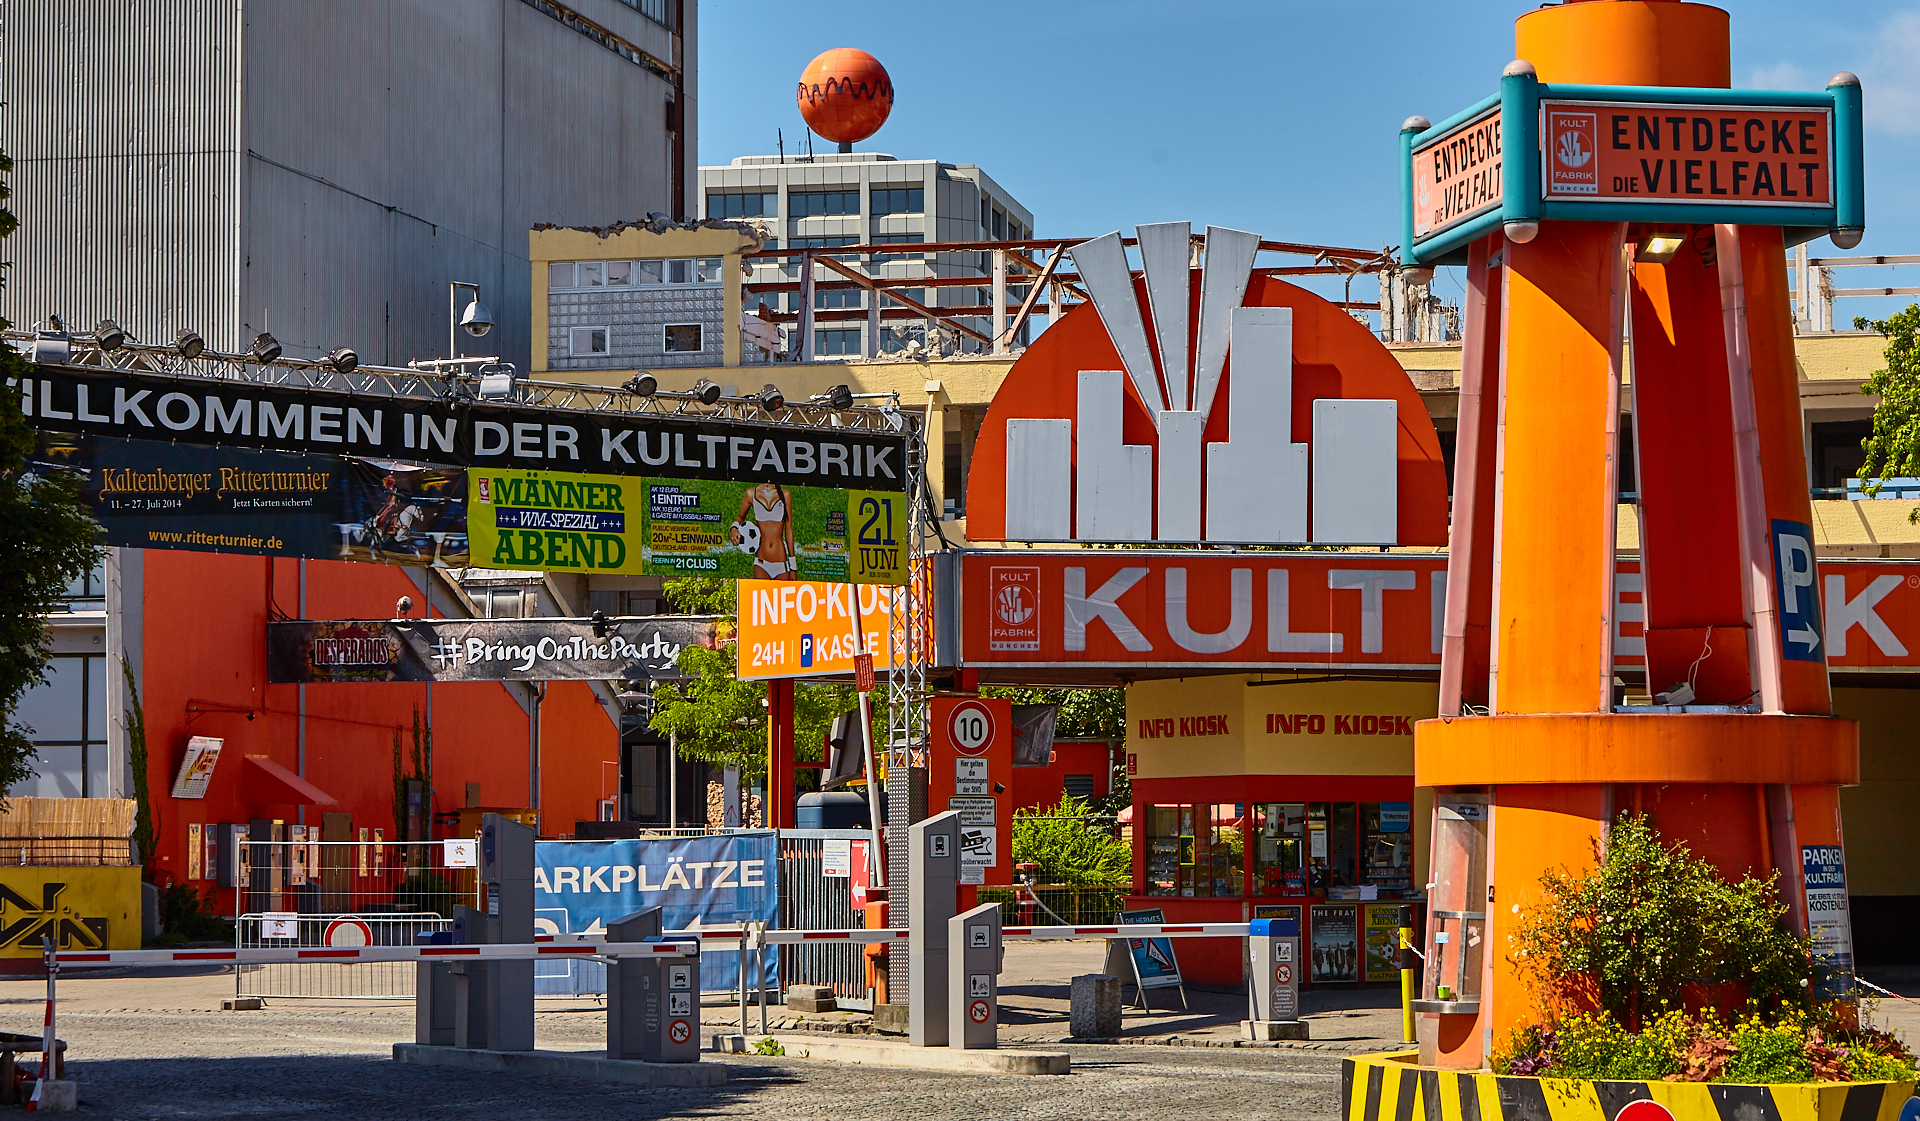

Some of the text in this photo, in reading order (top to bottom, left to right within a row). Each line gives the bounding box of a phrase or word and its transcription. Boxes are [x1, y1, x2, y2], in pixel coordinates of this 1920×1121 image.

[1560, 119, 1588, 128] KULT
[1612, 114, 1817, 154] ENTDECKE
[1433, 119, 1501, 184] ENTDECKE
[1555, 171, 1593, 180] FABRIK
[1613, 158, 1820, 197] DIE VIELFALT
[1434, 162, 1502, 225] DIE VIELFALT
[6, 377, 897, 479] ILLKOMMEN IN DER KULTFABRIK
[99, 466, 331, 501] Kaltenberger Ritterturnier
[493, 472, 625, 511] MÄNNER
[111, 499, 123, 509] 11.
[131, 499, 145, 509] 27.
[146, 499, 161, 510] Juli
[162, 498, 182, 509] 2014
[233, 498, 313, 510] Jetzt Karten sichern!
[652, 493, 698, 506] 1 EINTRITT
[520, 511, 600, 530] WM-SPEZIAL
[859, 497, 899, 546] 21.
[149, 530, 283, 549] www.ritterturnier.de
[492, 529, 626, 569] ABEND
[676, 558, 685, 569] 21
[686, 558, 717, 570] CLUBS
[859, 547, 899, 575] JUNI
[1000, 573, 1031, 582] KULT
[994, 628, 1035, 637] FABRIK
[315, 631, 680, 672] DESPERADOS #BringOnTheParty
[752, 641, 785, 667] 24H
[960, 717, 983, 742] 10
[1139, 714, 1230, 739] INFO KIOSK
[1266, 713, 1413, 736] INFO KIOSK
[970, 760, 984, 768] gelten
[957, 777, 988, 785] Bestimmungen
[1803, 848, 1843, 866] PARKEN
[534, 856, 765, 894] ARKPLÄTZE
[1265, 866, 1281, 881] 24
[1312, 909, 1355, 917] THE FRAY
[1809, 900, 1847, 912] KOSTENLOS
[1135, 914, 1161, 923] HERMES
[1371, 918, 1399, 926] ABEND
